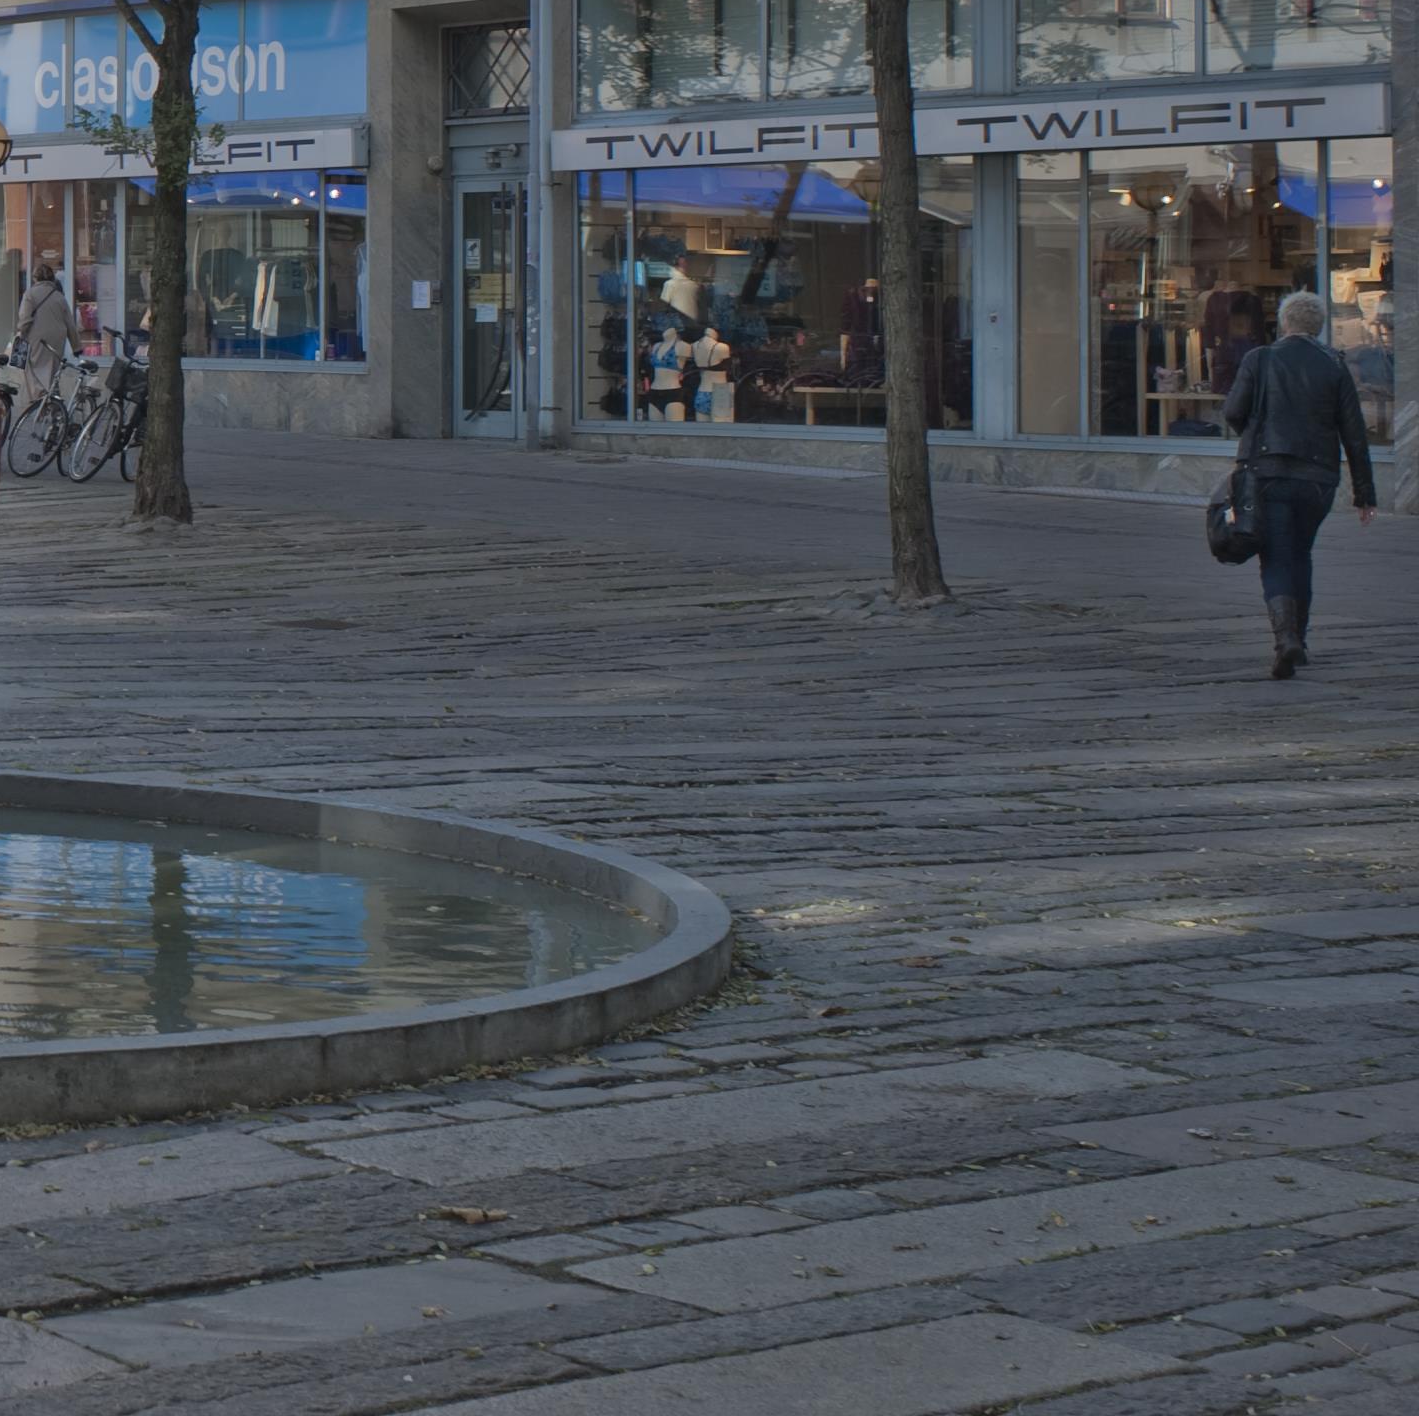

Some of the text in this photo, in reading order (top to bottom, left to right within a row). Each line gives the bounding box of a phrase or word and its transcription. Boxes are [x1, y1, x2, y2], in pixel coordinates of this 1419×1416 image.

[957, 97, 1326, 144] TWILFIT
[104, 139, 315, 170] TLFIT
[586, 122, 880, 160] TWILFIT
